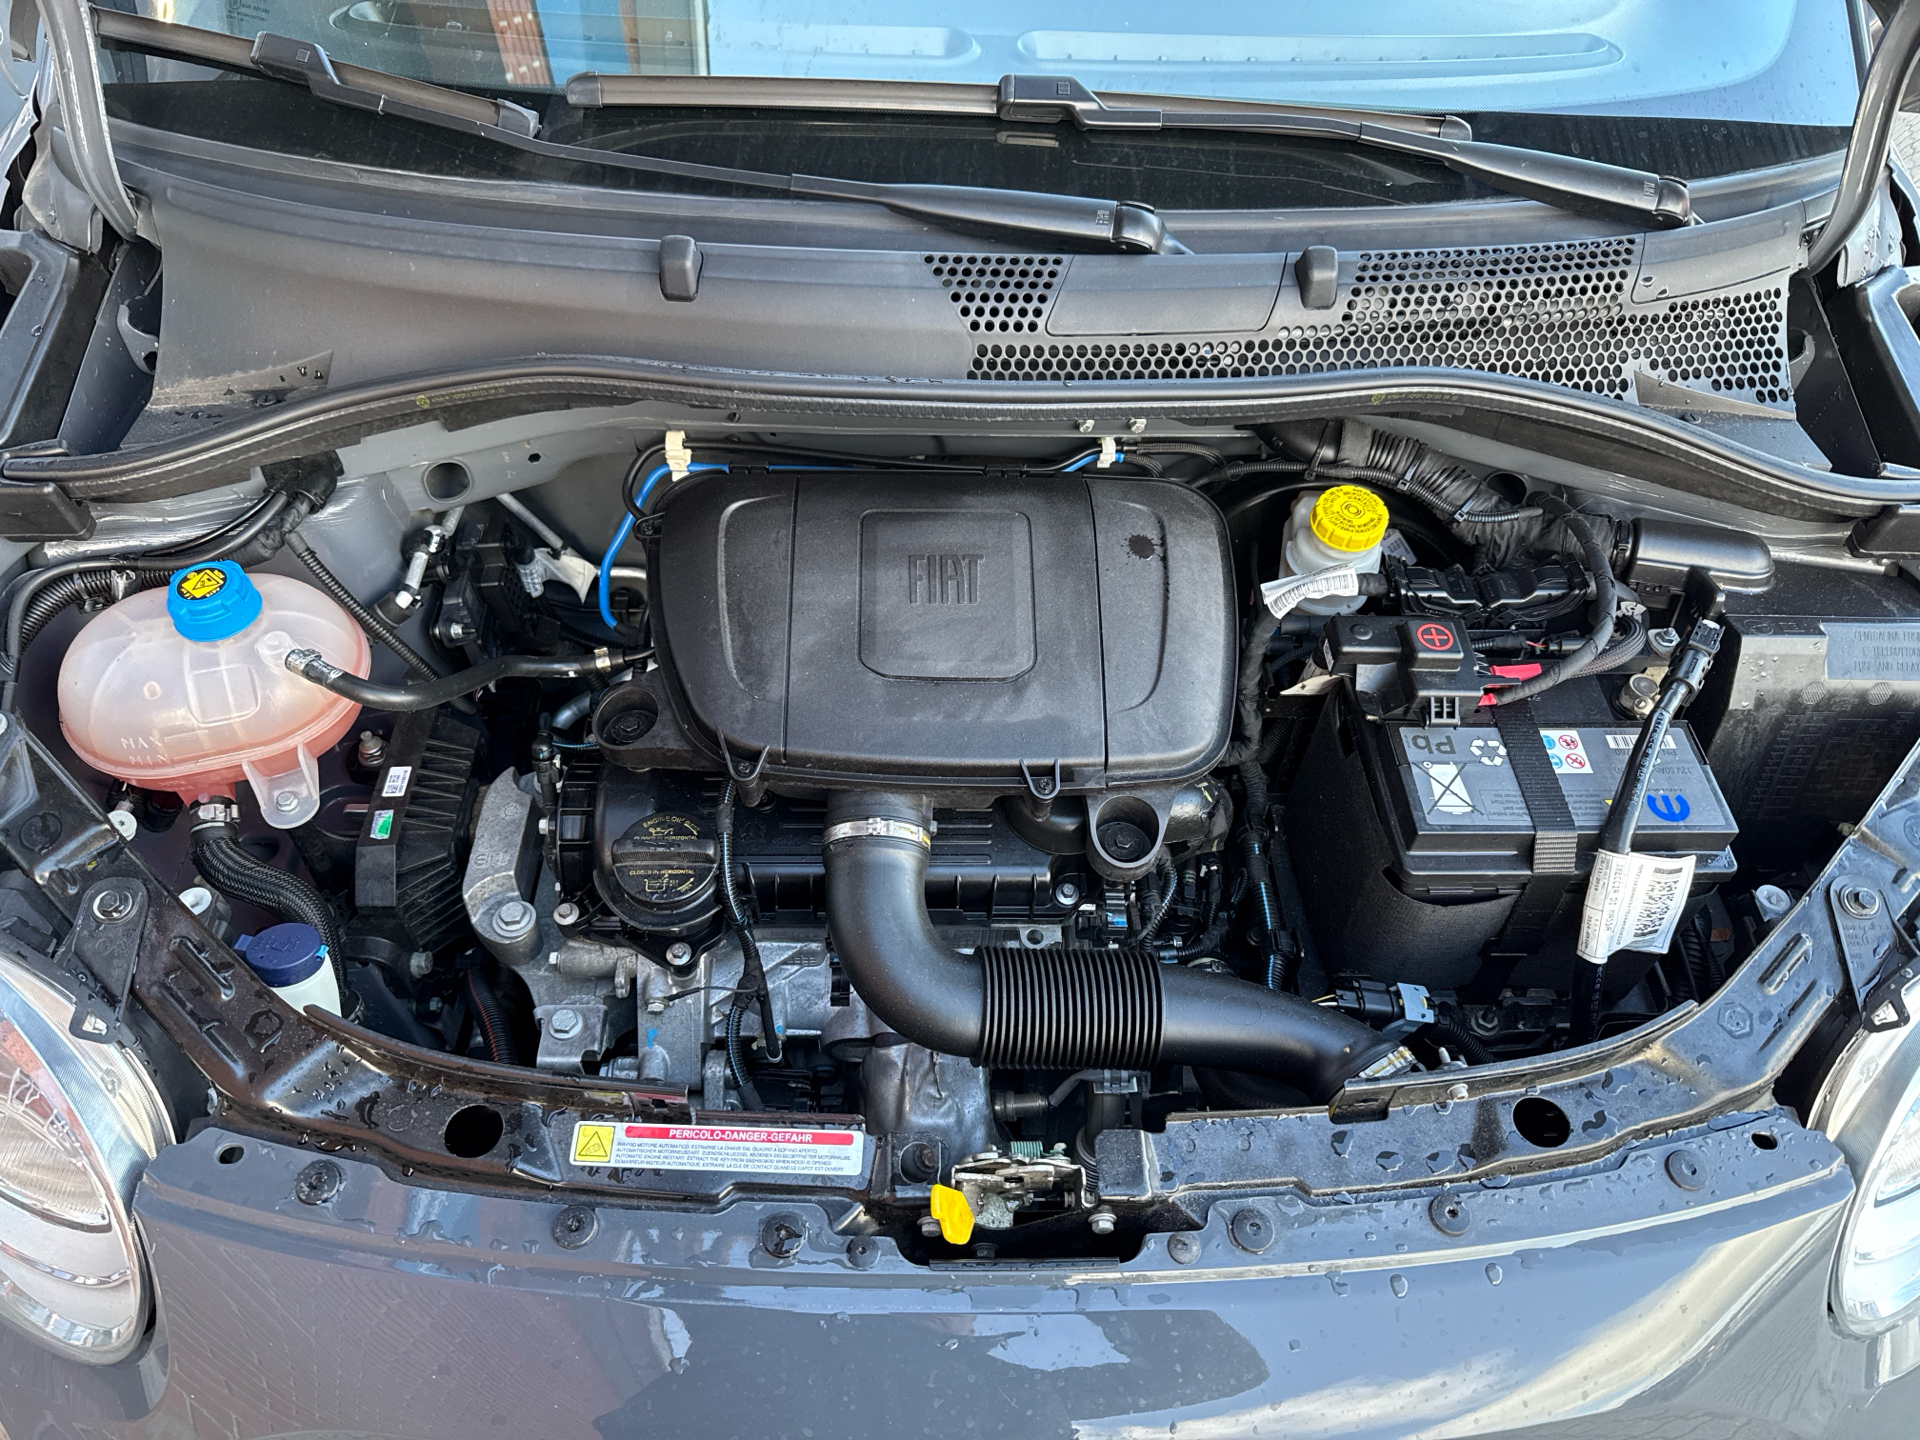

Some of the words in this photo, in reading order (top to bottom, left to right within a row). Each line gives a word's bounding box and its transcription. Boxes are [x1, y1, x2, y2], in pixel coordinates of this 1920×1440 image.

[908, 554, 985, 605] FIAT
[1411, 734, 1456, 754] Pb
[642, 815, 670, 829] ENGINE
[669, 1129, 813, 1143] PERICOLO-DANGER-GEFAHR
